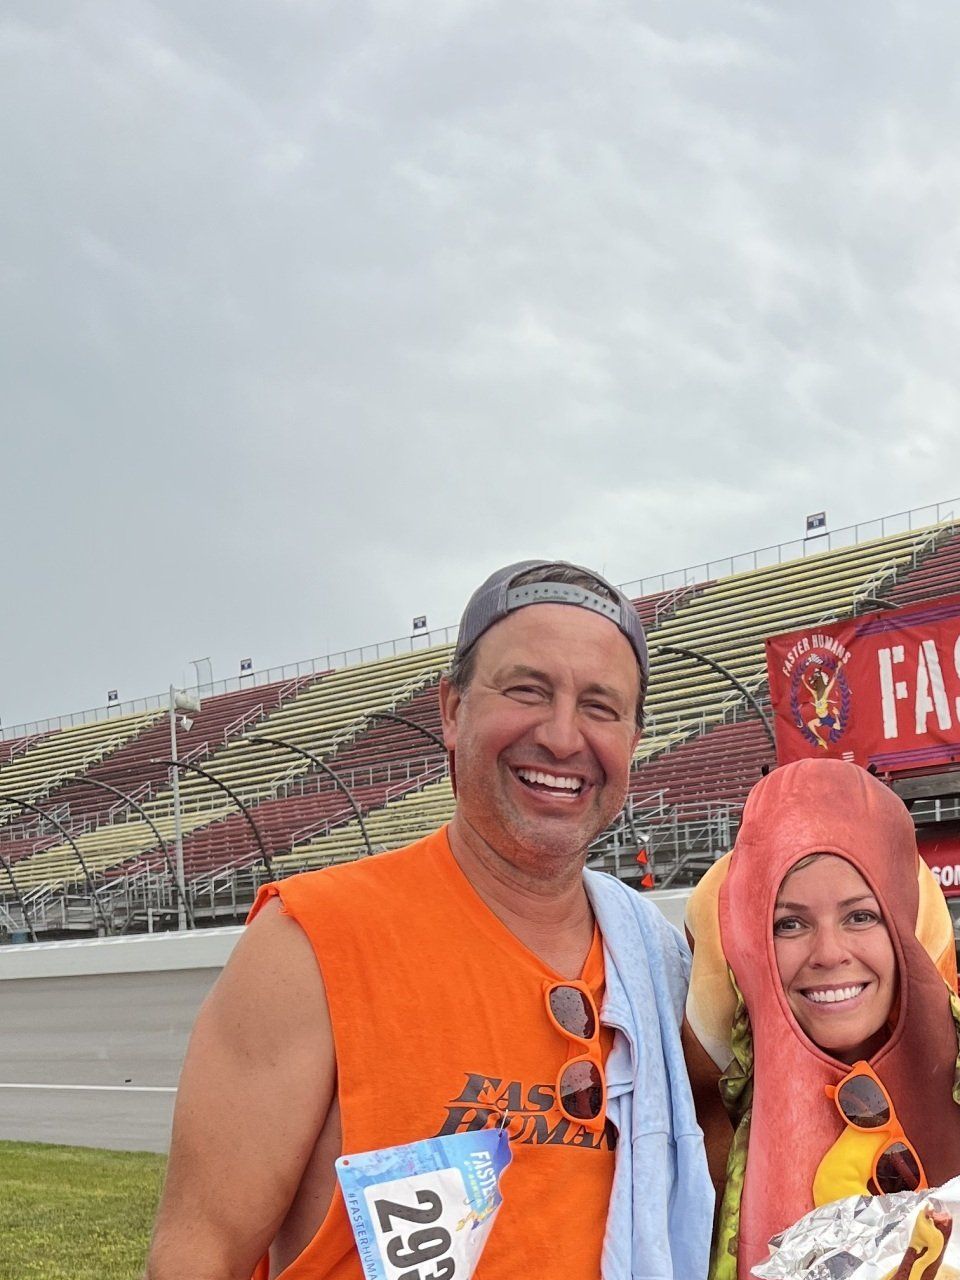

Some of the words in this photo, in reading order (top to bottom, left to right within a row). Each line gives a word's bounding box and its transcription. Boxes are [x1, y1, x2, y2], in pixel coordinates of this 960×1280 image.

[782, 638, 811, 677] FASTER
[811, 634, 852, 664] HUMANS
[449, 1072, 557, 1112] FAS
